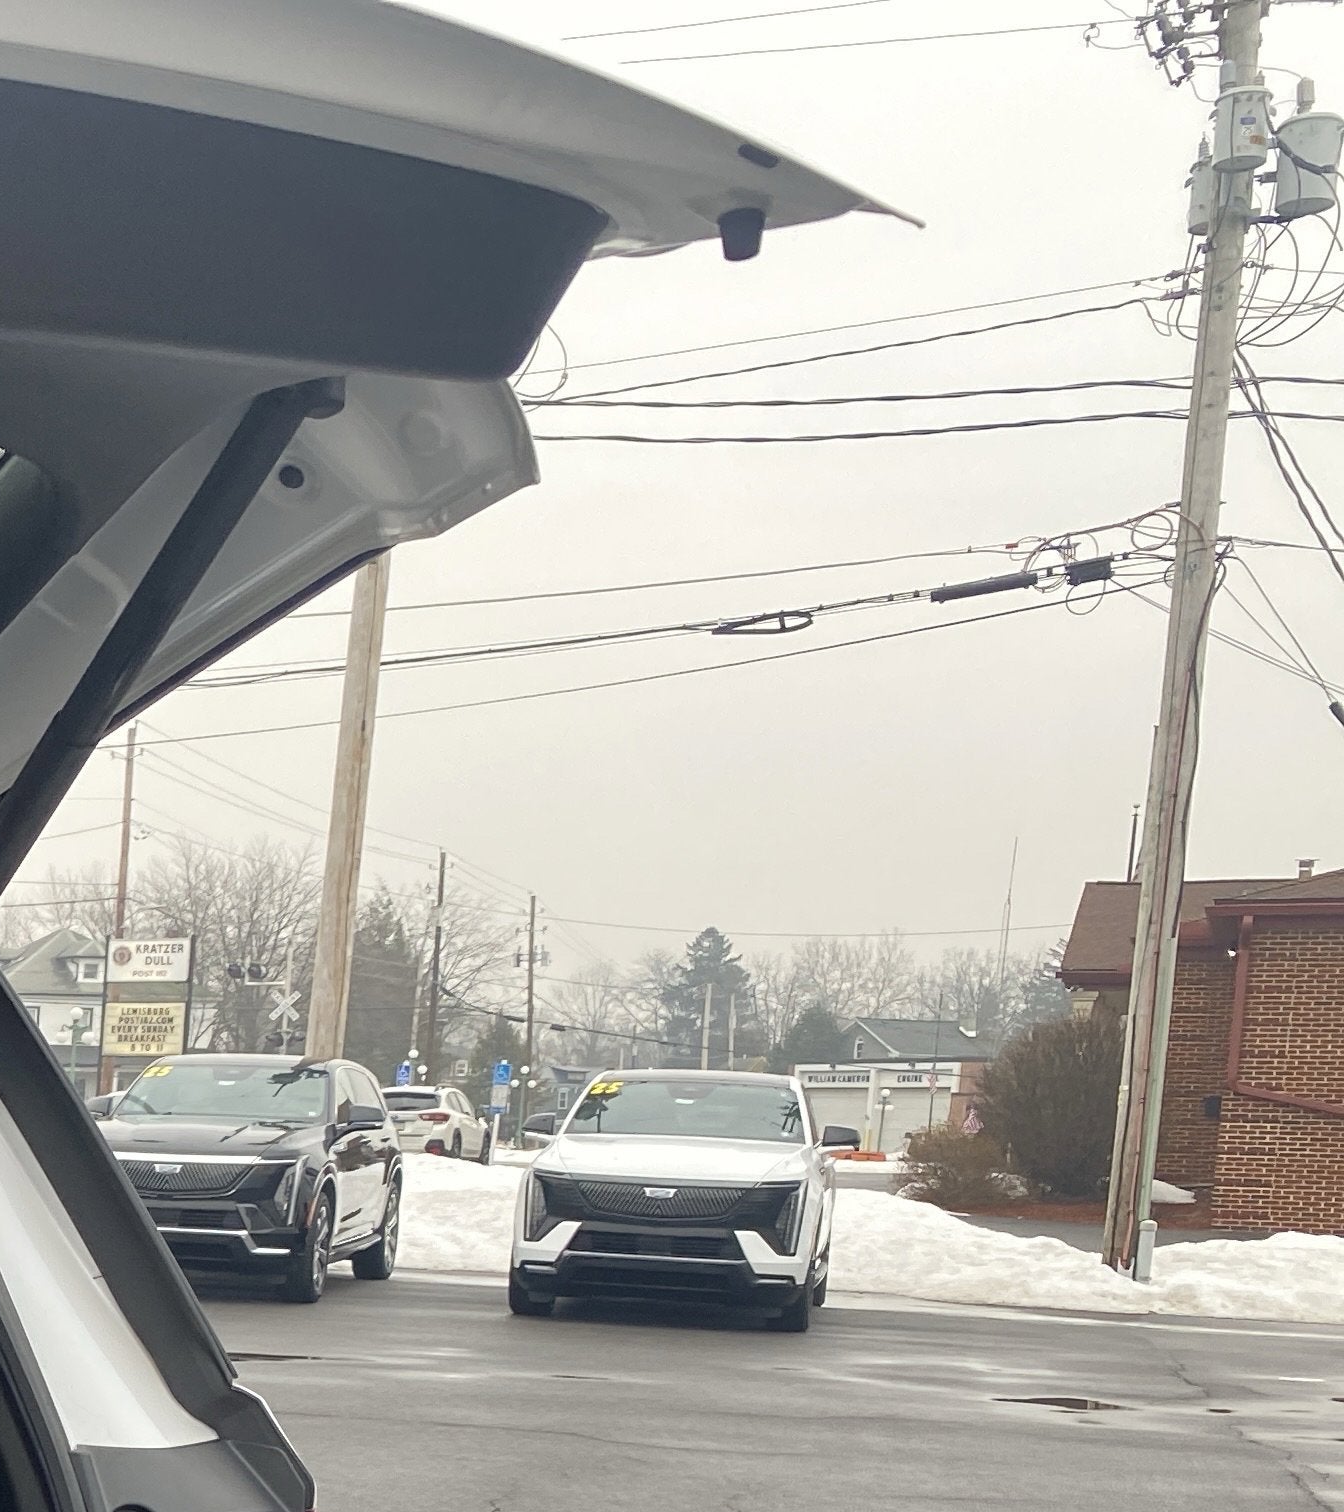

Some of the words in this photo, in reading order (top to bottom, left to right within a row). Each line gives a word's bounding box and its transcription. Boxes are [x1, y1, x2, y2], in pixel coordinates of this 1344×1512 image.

[135, 943, 184, 954] KRATZER
[144, 956, 173, 966] DULL
[132, 969, 154, 977] POST
[121, 1007, 170, 1016] LEWISBURG
[111, 1025, 139, 1034] EVERY
[141, 1025, 175, 1034] SUNDAY
[117, 1034, 166, 1043] BREAKFAST
[140, 1043, 152, 1052] TO
[808, 1075, 837, 1083] WILLIAM
[590, 1081, 624, 1095] 25
